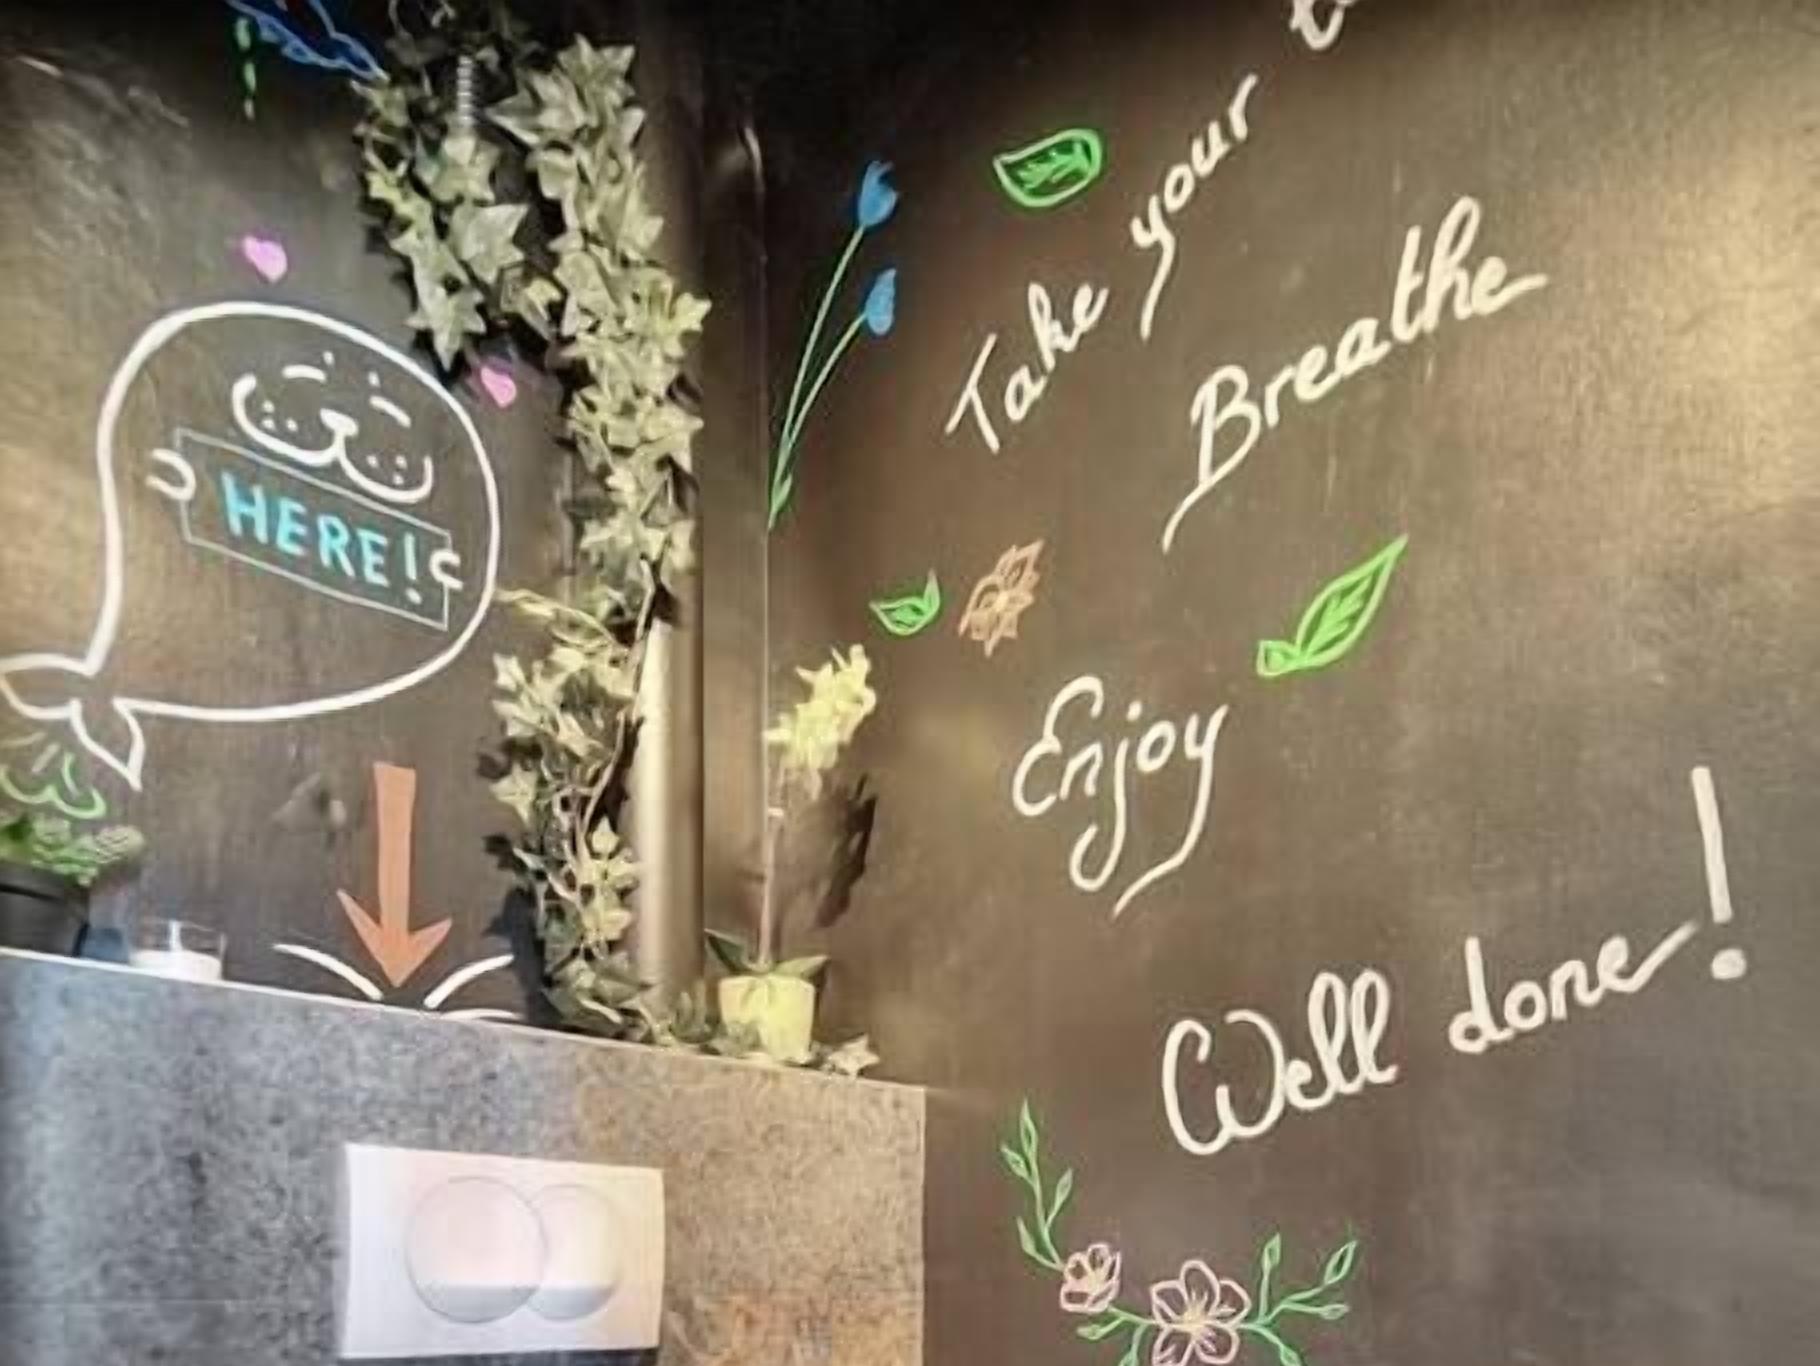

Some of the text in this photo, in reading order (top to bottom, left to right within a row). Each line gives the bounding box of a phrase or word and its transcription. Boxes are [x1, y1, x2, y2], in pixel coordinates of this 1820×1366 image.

[945, 74, 1257, 454] Take your
[1162, 197, 1549, 555] Breathe
[221, 471, 423, 604] HERE!
[1012, 675, 1229, 919] Enjoy
[1161, 968, 1400, 1156] Well
